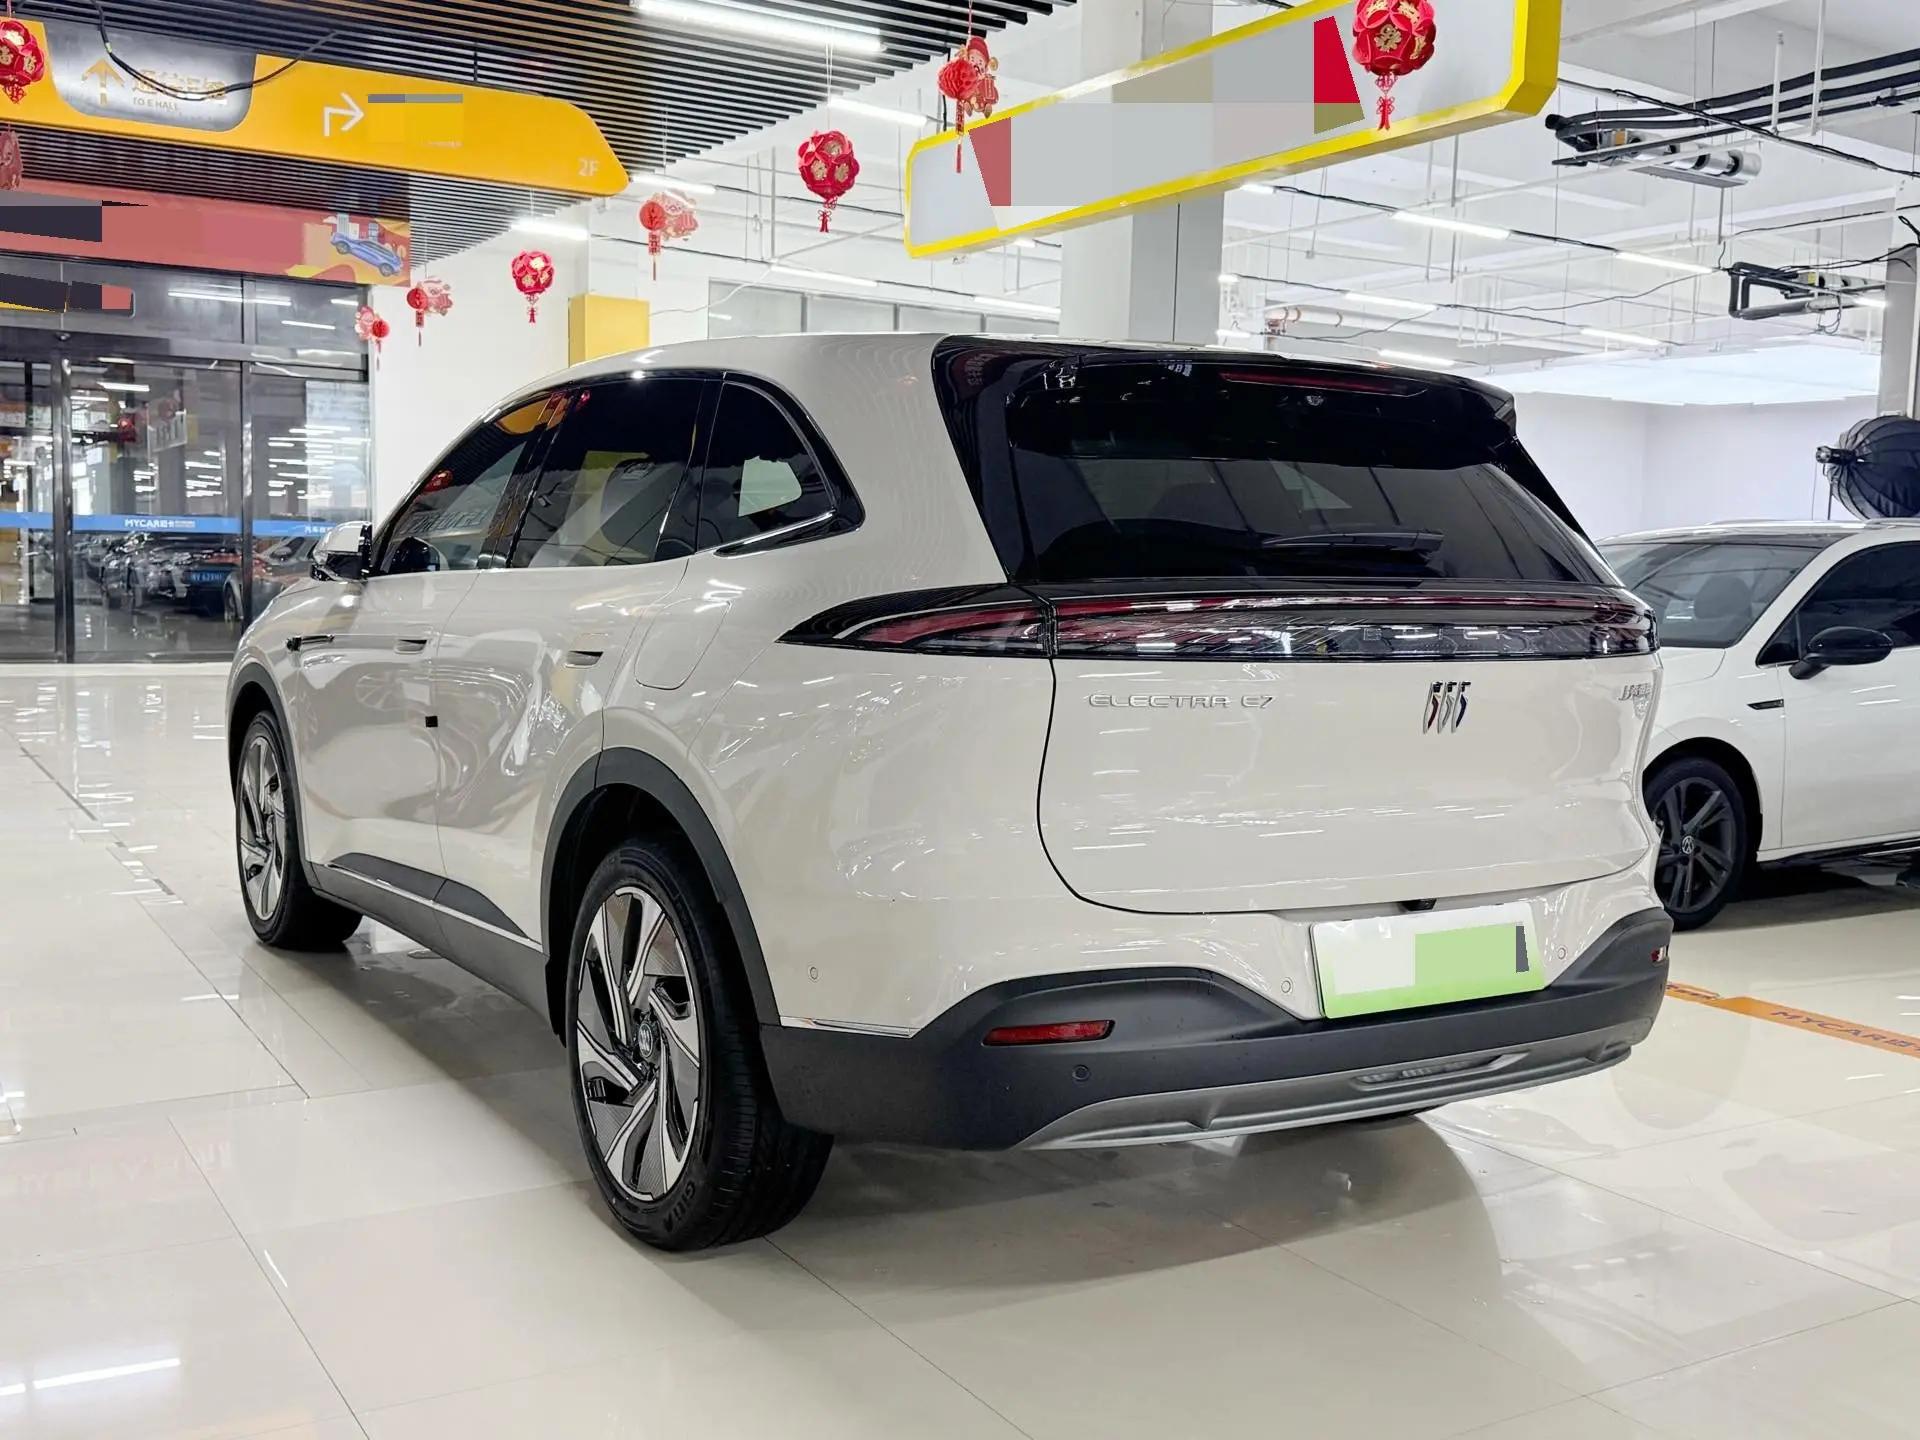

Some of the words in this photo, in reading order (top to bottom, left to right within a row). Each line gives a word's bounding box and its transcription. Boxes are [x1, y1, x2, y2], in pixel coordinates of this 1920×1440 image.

[578, 157, 600, 177] 2F
[1089, 693, 1230, 709] ELECTRA
[1241, 694, 1277, 709] E7
